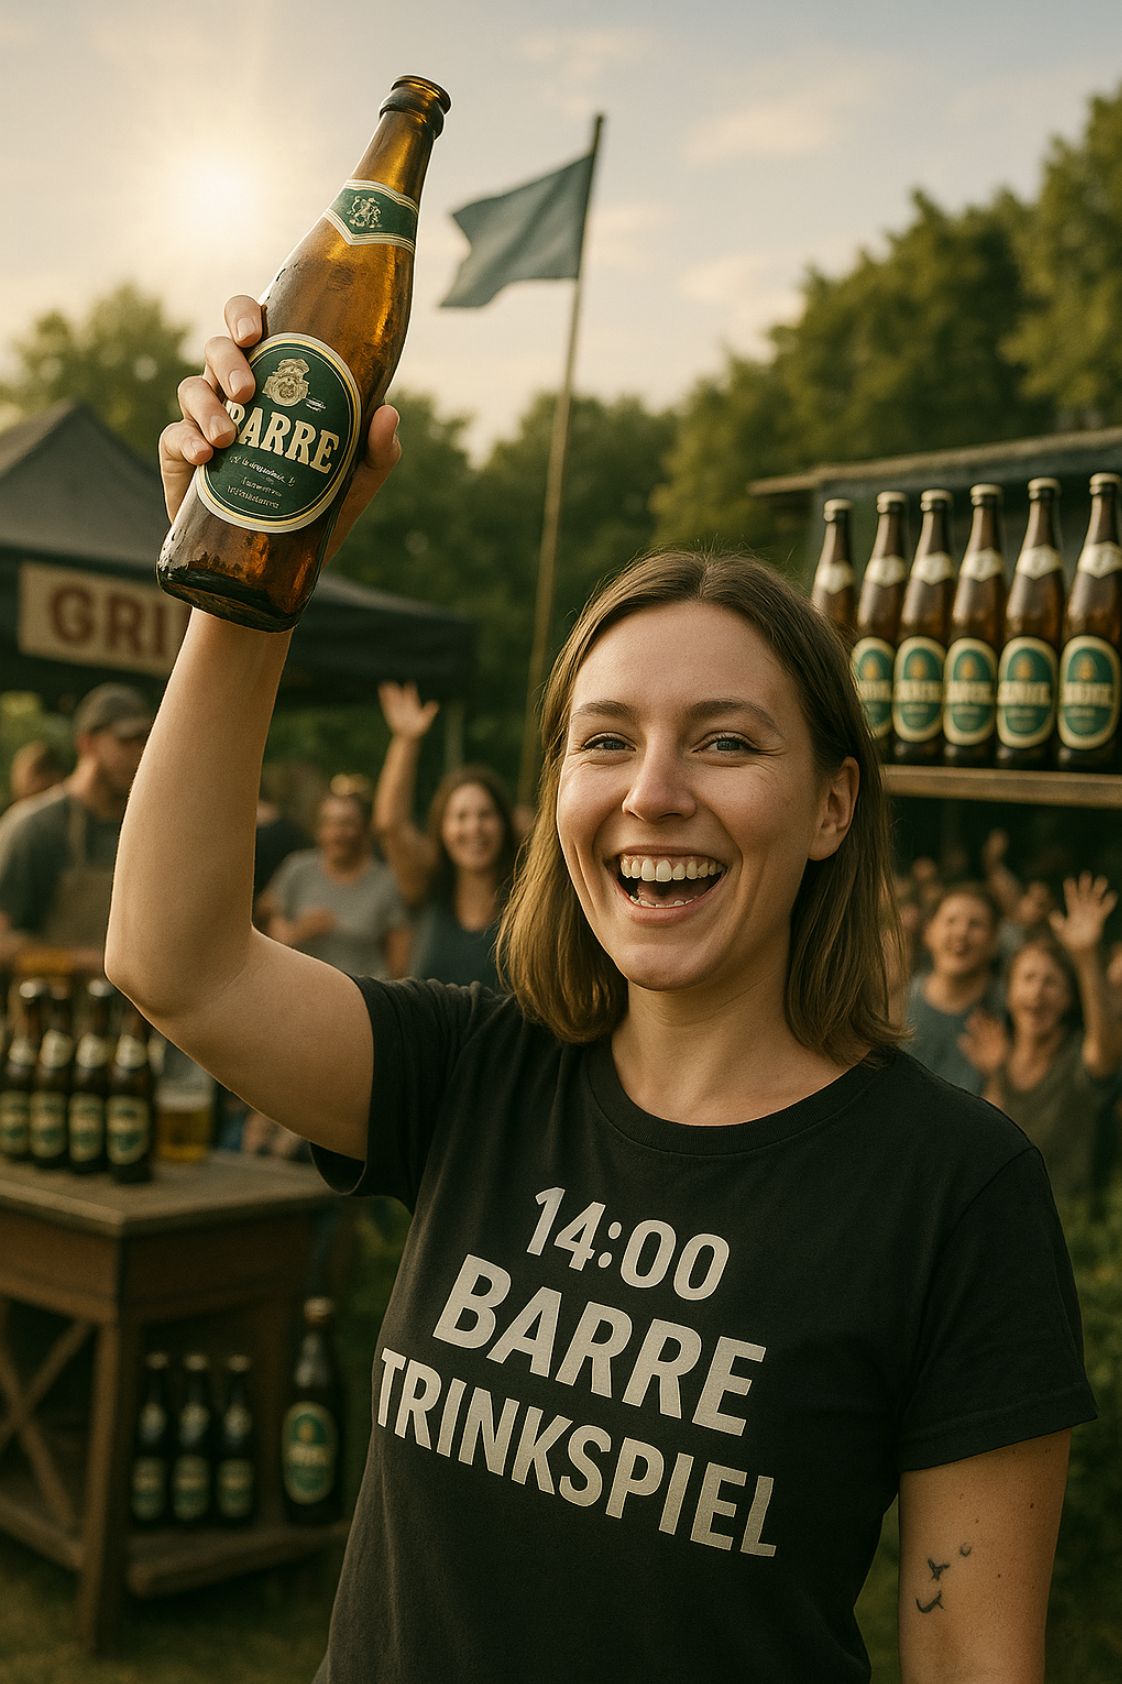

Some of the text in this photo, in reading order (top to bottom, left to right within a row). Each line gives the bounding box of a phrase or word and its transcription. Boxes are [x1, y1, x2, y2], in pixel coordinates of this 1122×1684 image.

[49, 581, 190, 659] GRI
[526, 1186, 730, 1301] 14:00
[432, 1253, 767, 1437] BARRE
[377, 1347, 777, 1558] TRINKSPIEL
